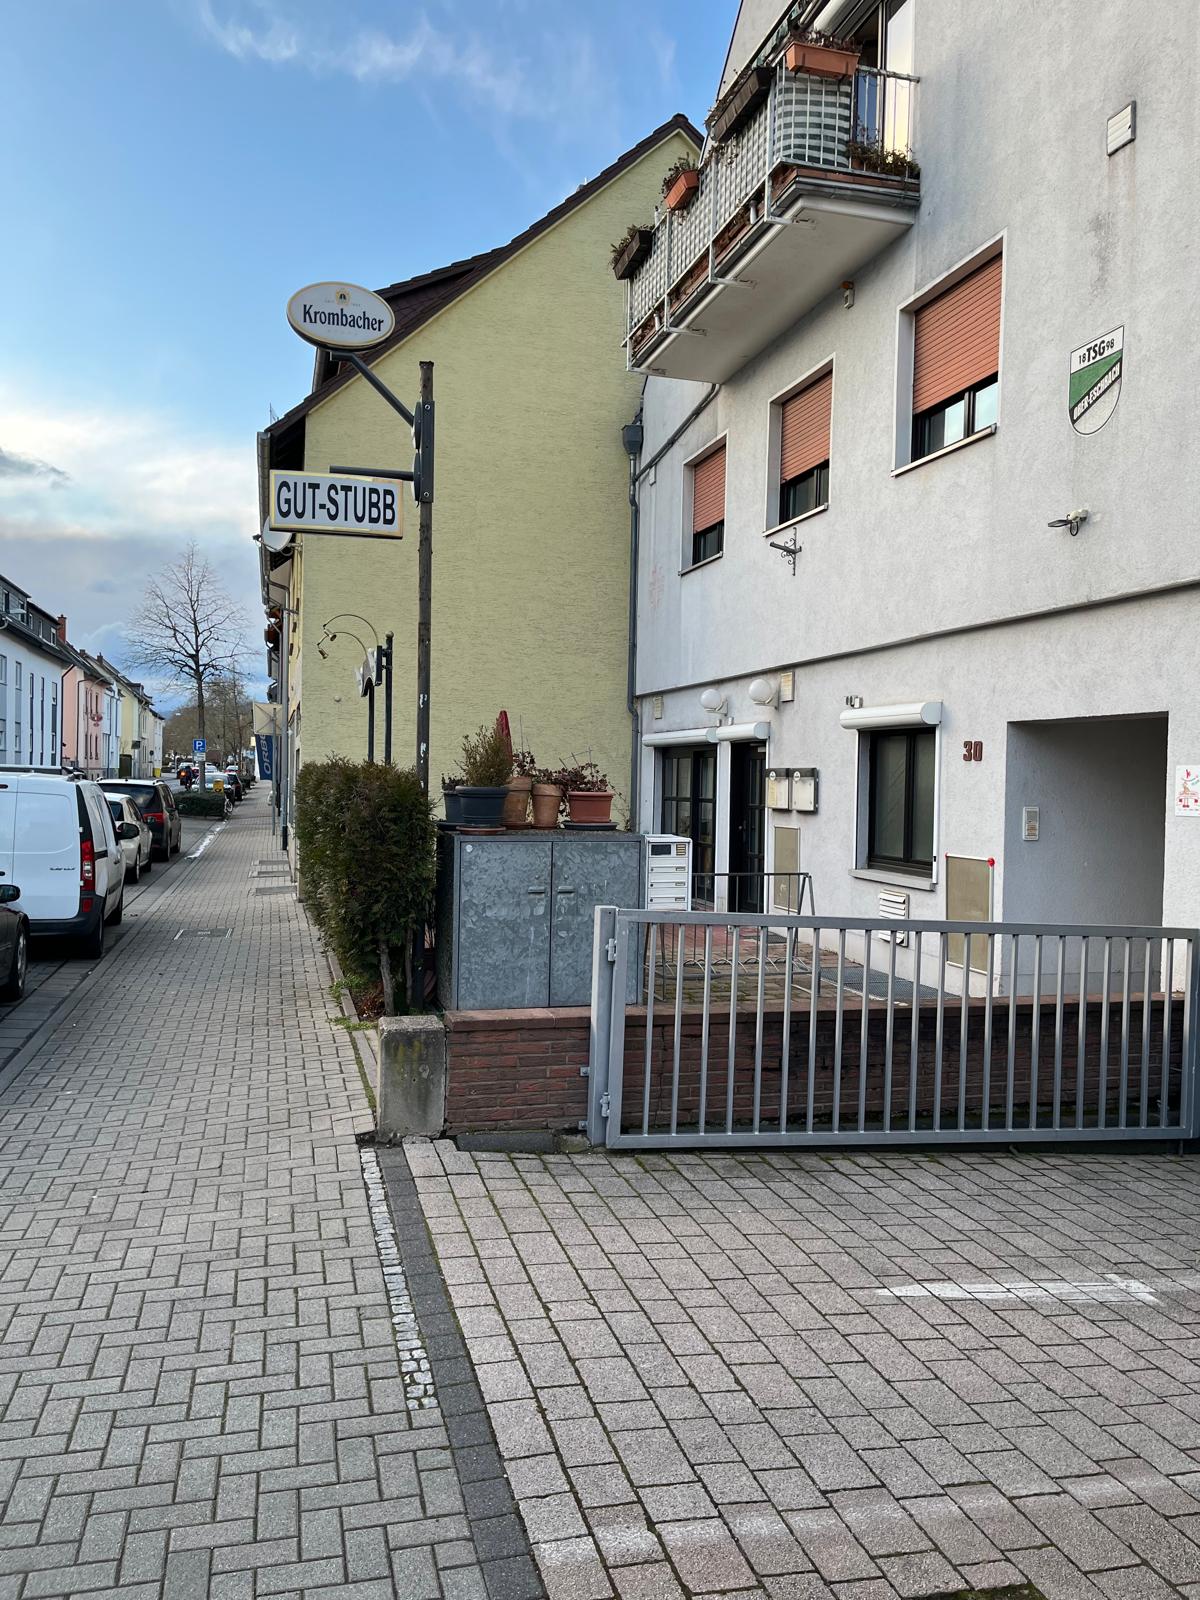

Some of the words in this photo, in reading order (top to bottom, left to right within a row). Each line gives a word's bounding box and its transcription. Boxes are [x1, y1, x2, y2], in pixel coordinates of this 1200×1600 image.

[303, 304, 384, 332] Krombacher
[1078, 353, 1086, 365] 18
[1086, 340, 1106, 362] TSG
[1106, 338, 1115, 351] 98
[276, 480, 396, 525] GUT-STUBB
[963, 741, 983, 762] 30
